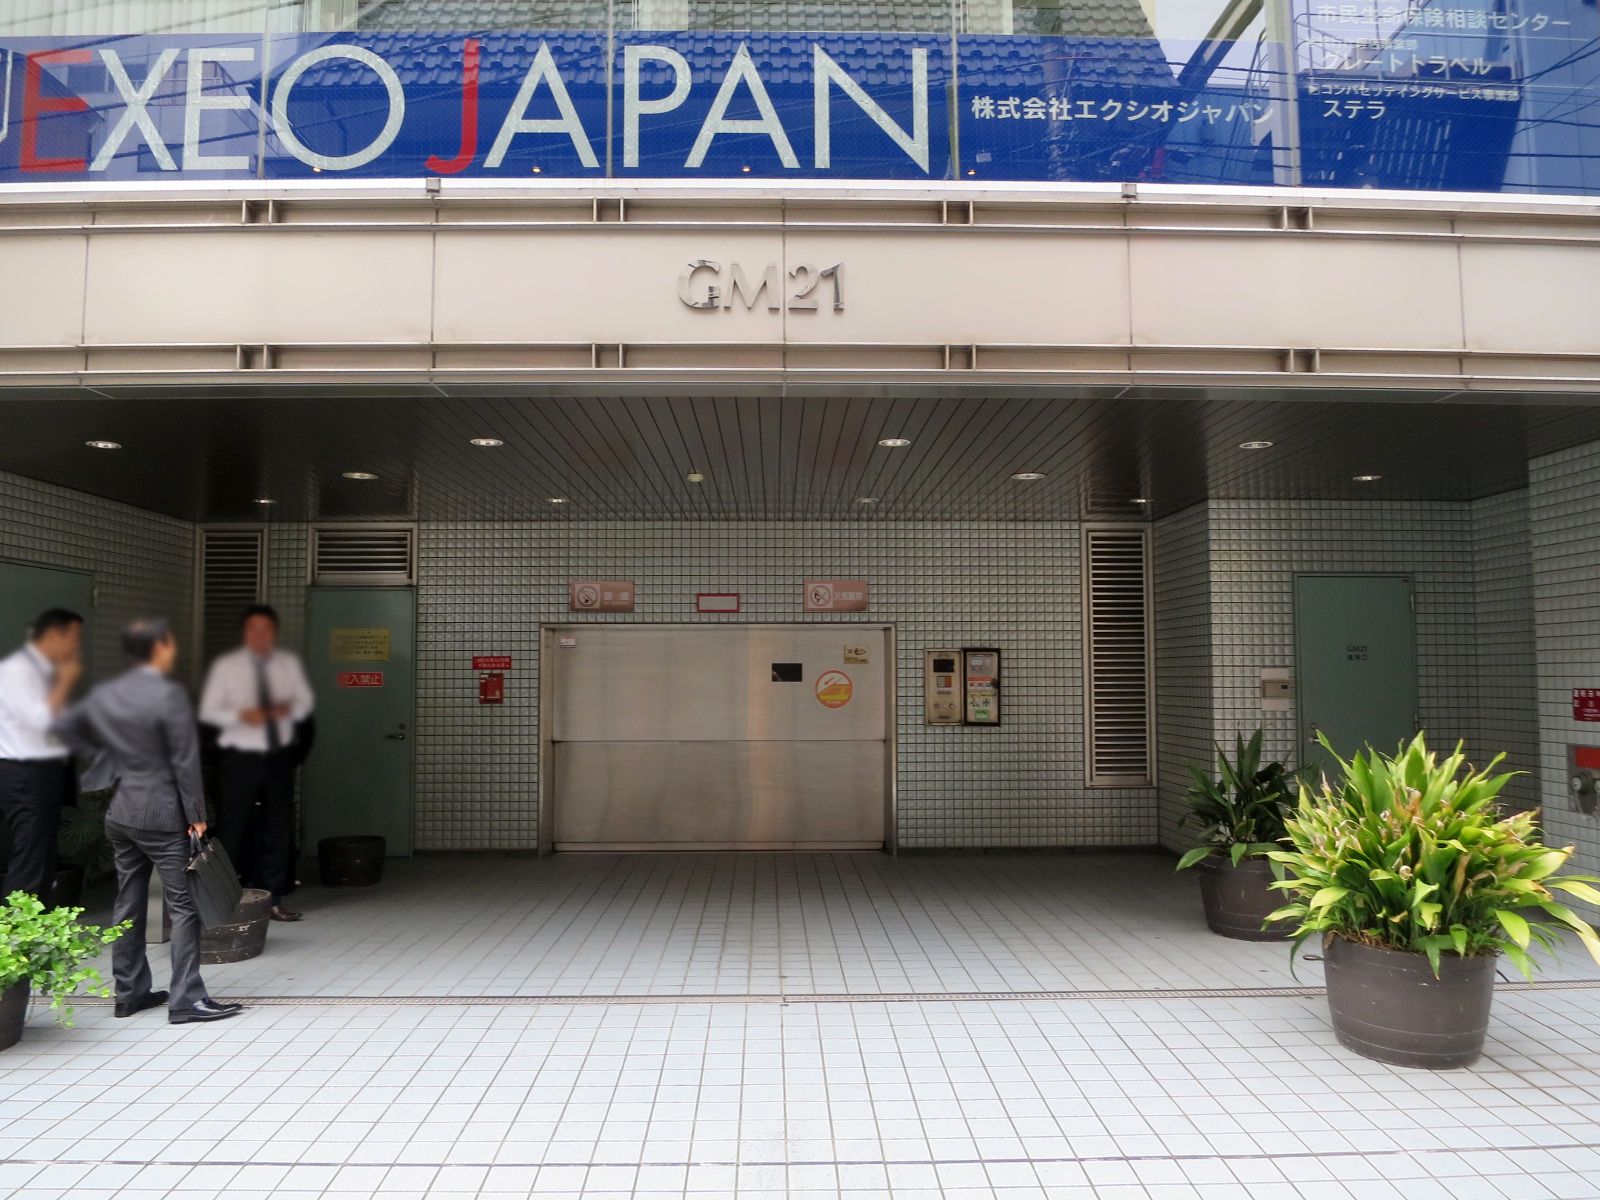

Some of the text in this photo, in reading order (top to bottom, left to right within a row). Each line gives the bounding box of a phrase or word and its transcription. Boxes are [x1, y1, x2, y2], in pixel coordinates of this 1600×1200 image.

[20, 39, 930, 174] EXEO JAPAN
[971, 95, 1275, 125] 株式会社エクシオジャパン
[1323, 99, 1387, 119] ステラ
[678, 259, 846, 312] GM21
[341, 674, 381, 686] 入禁止
